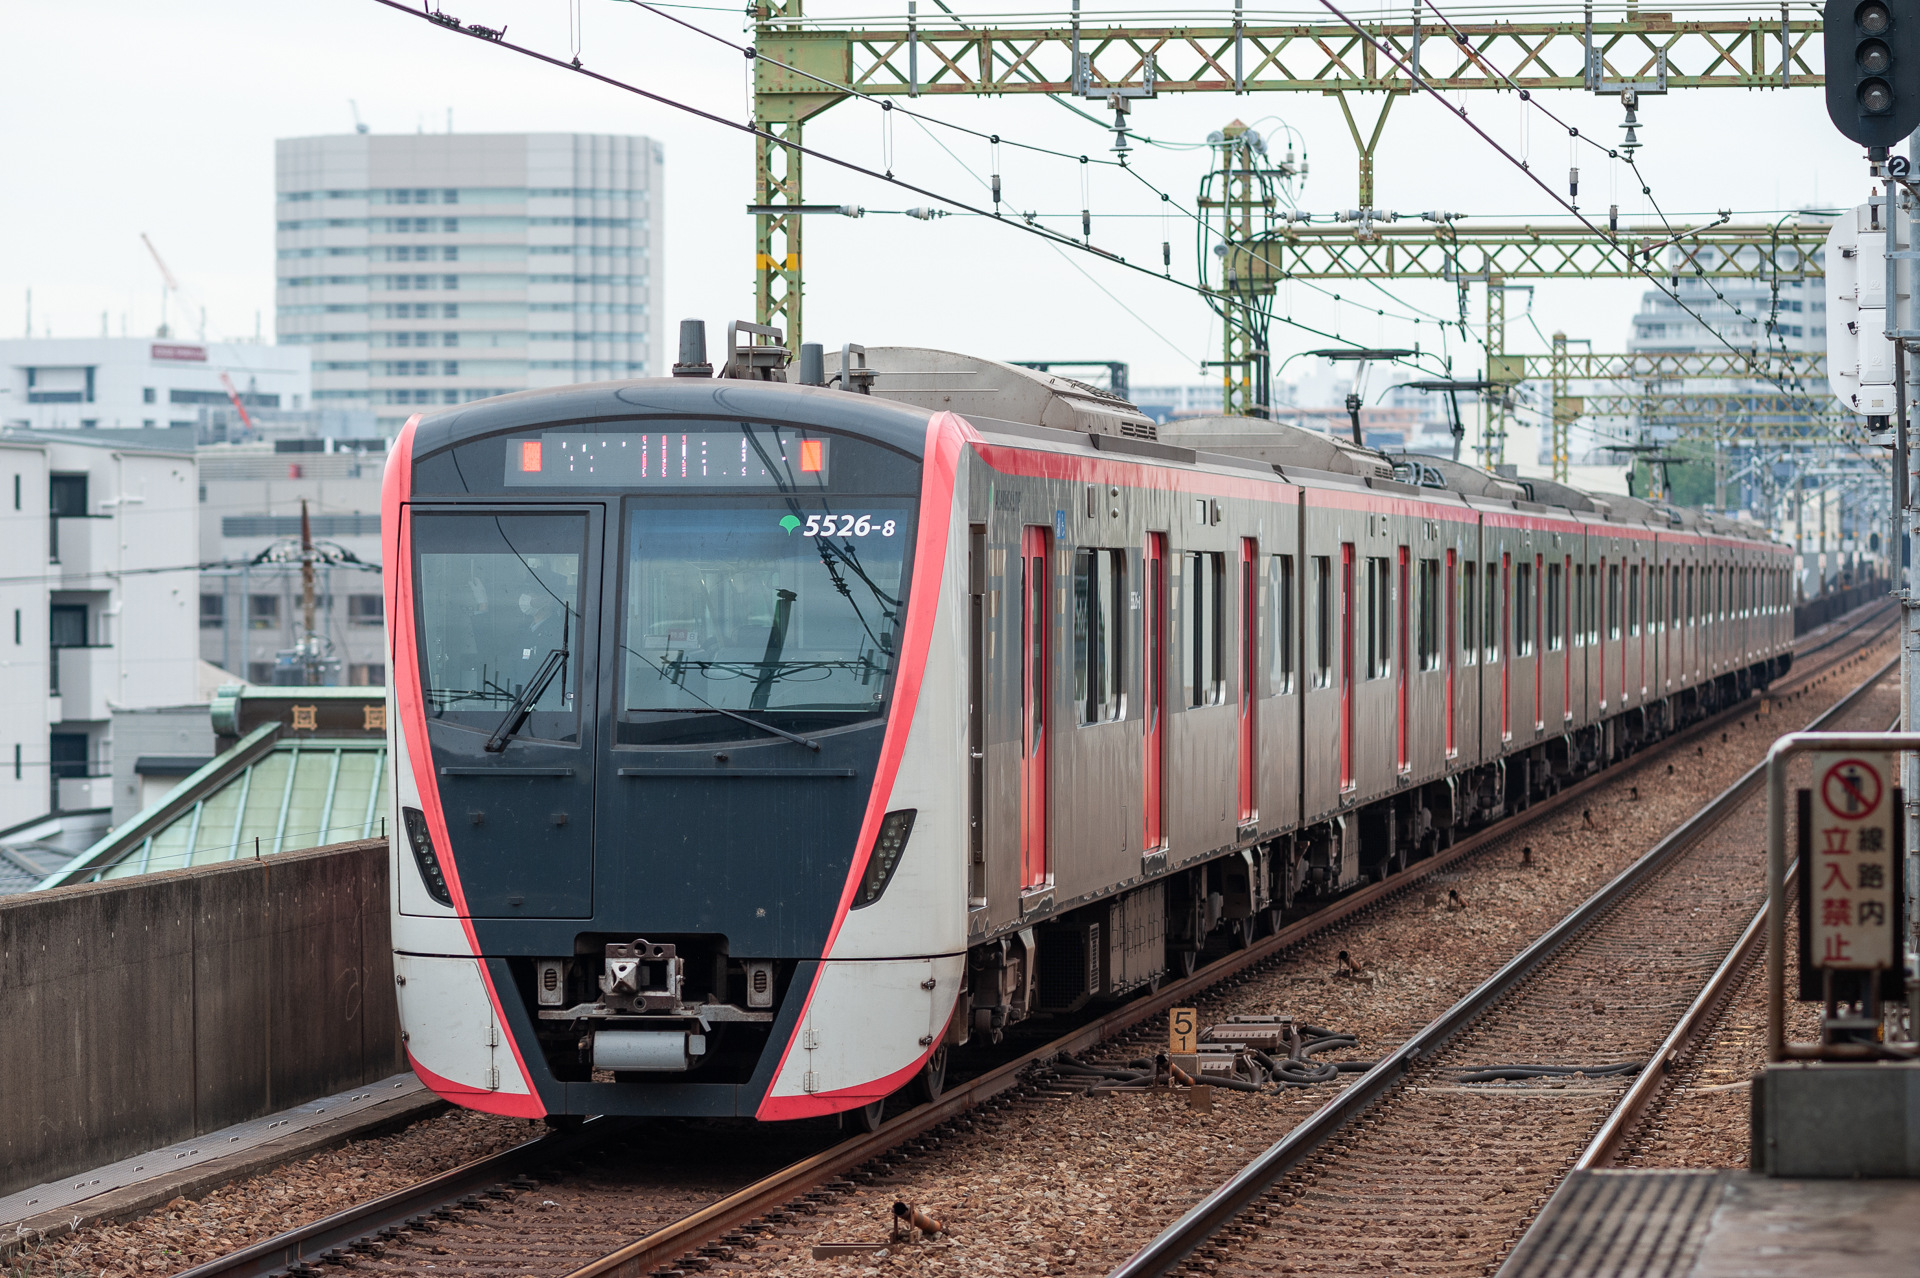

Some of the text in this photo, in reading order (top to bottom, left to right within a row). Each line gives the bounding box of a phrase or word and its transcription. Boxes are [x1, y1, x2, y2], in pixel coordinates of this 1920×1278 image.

[1892, 158, 1906, 176] 2
[803, 514, 896, 537] 5526-8
[1857, 826, 1885, 926] 線路内
[1821, 826, 1852, 963] 立入禁止
[1174, 1011, 1193, 1035] 5
[1178, 1036, 1187, 1051] 1
